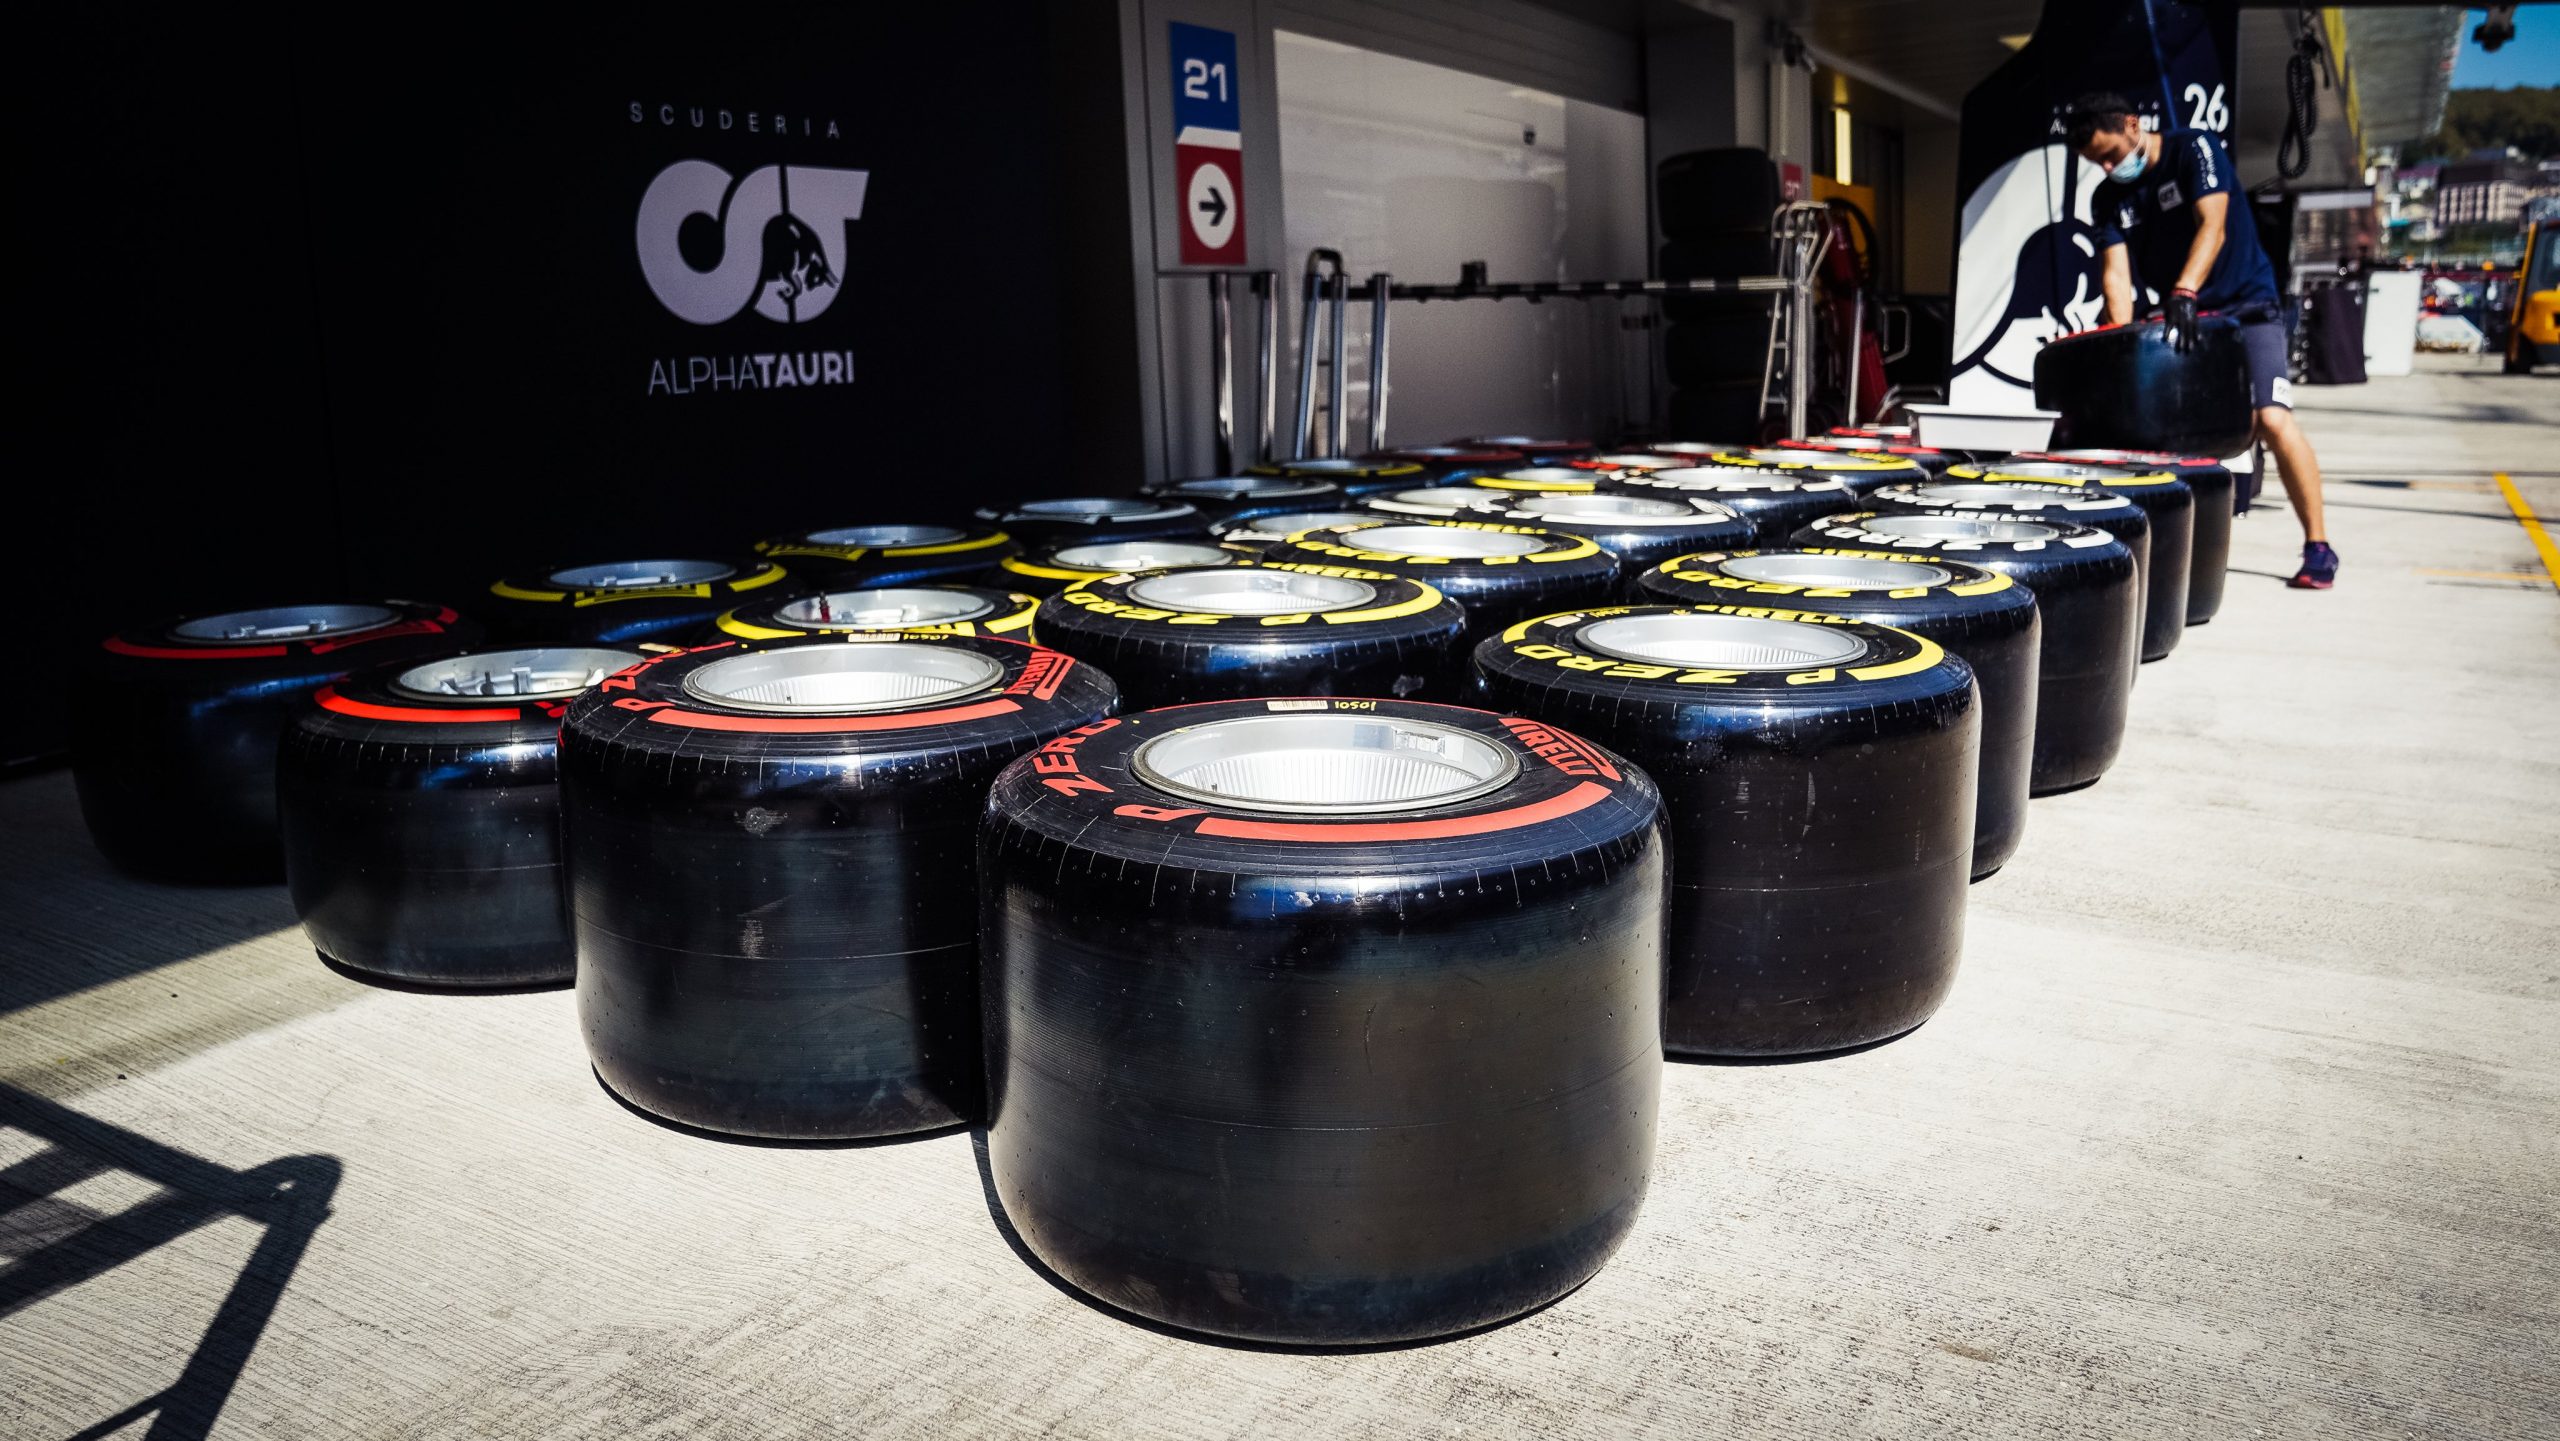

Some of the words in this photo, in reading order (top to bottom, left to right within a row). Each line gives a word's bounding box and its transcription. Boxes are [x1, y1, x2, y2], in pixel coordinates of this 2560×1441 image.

[1183, 58, 1228, 103] 21
[629, 100, 841, 140] SCUDERIA
[2184, 82, 2229, 133] 26
[648, 350, 855, 397] ALPHATAURI
[1261, 562, 1398, 580] PIRELLI
[1672, 571, 1859, 598] ZERO
[1063, 592, 1233, 625] ZERO
[1695, 605, 1864, 625] PIRELLI
[1002, 651, 1076, 701] PIRELLI
[1514, 644, 1749, 684] ZERO
[1786, 668, 1836, 685] P
[1033, 718, 1122, 797] ZERO
[1498, 717, 1622, 781] PIRELLI
[1113, 804, 1211, 822] P
